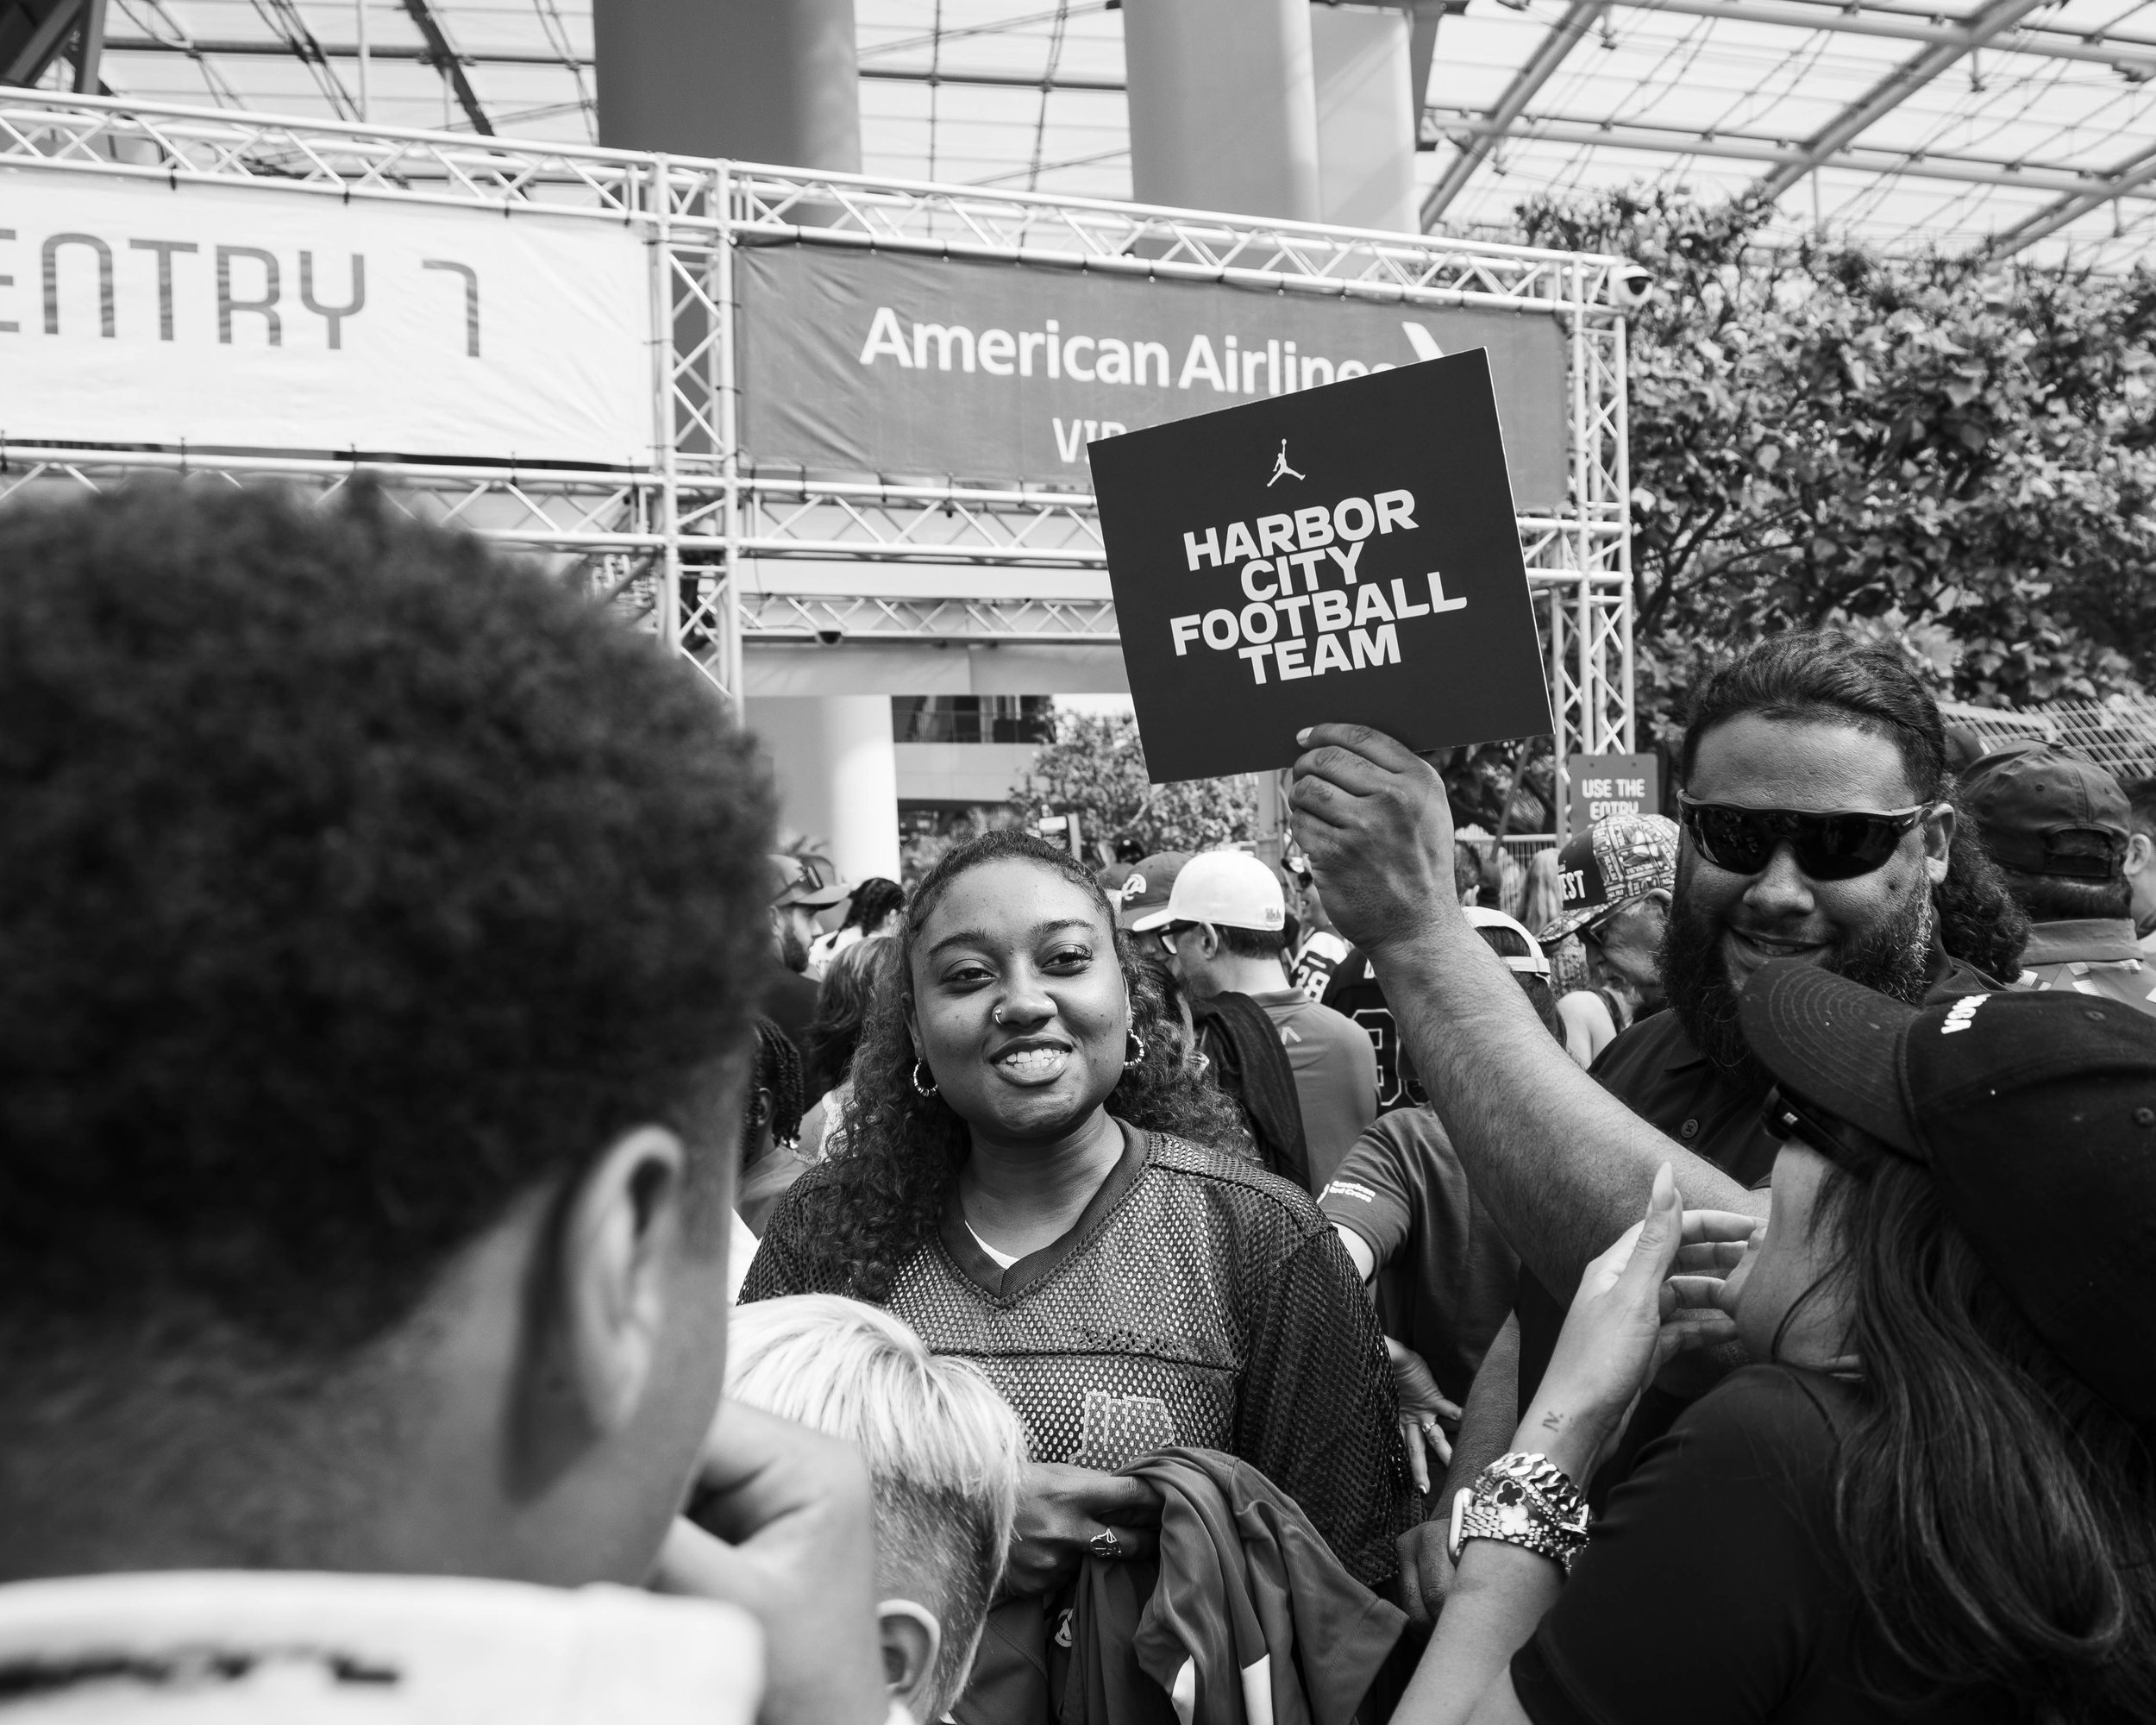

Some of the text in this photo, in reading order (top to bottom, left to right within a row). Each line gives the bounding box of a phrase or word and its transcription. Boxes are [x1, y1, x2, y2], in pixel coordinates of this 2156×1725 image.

[423, 260, 480, 358] 7
[859, 306, 1397, 396] American Airlin
[1184, 489, 1420, 572] HARBOR
[1240, 541, 1365, 602] CITY
[1169, 571, 1468, 656] FOOTBALL
[1238, 623, 1401, 685] TEAM
[1582, 779, 1645, 799] USE THE
